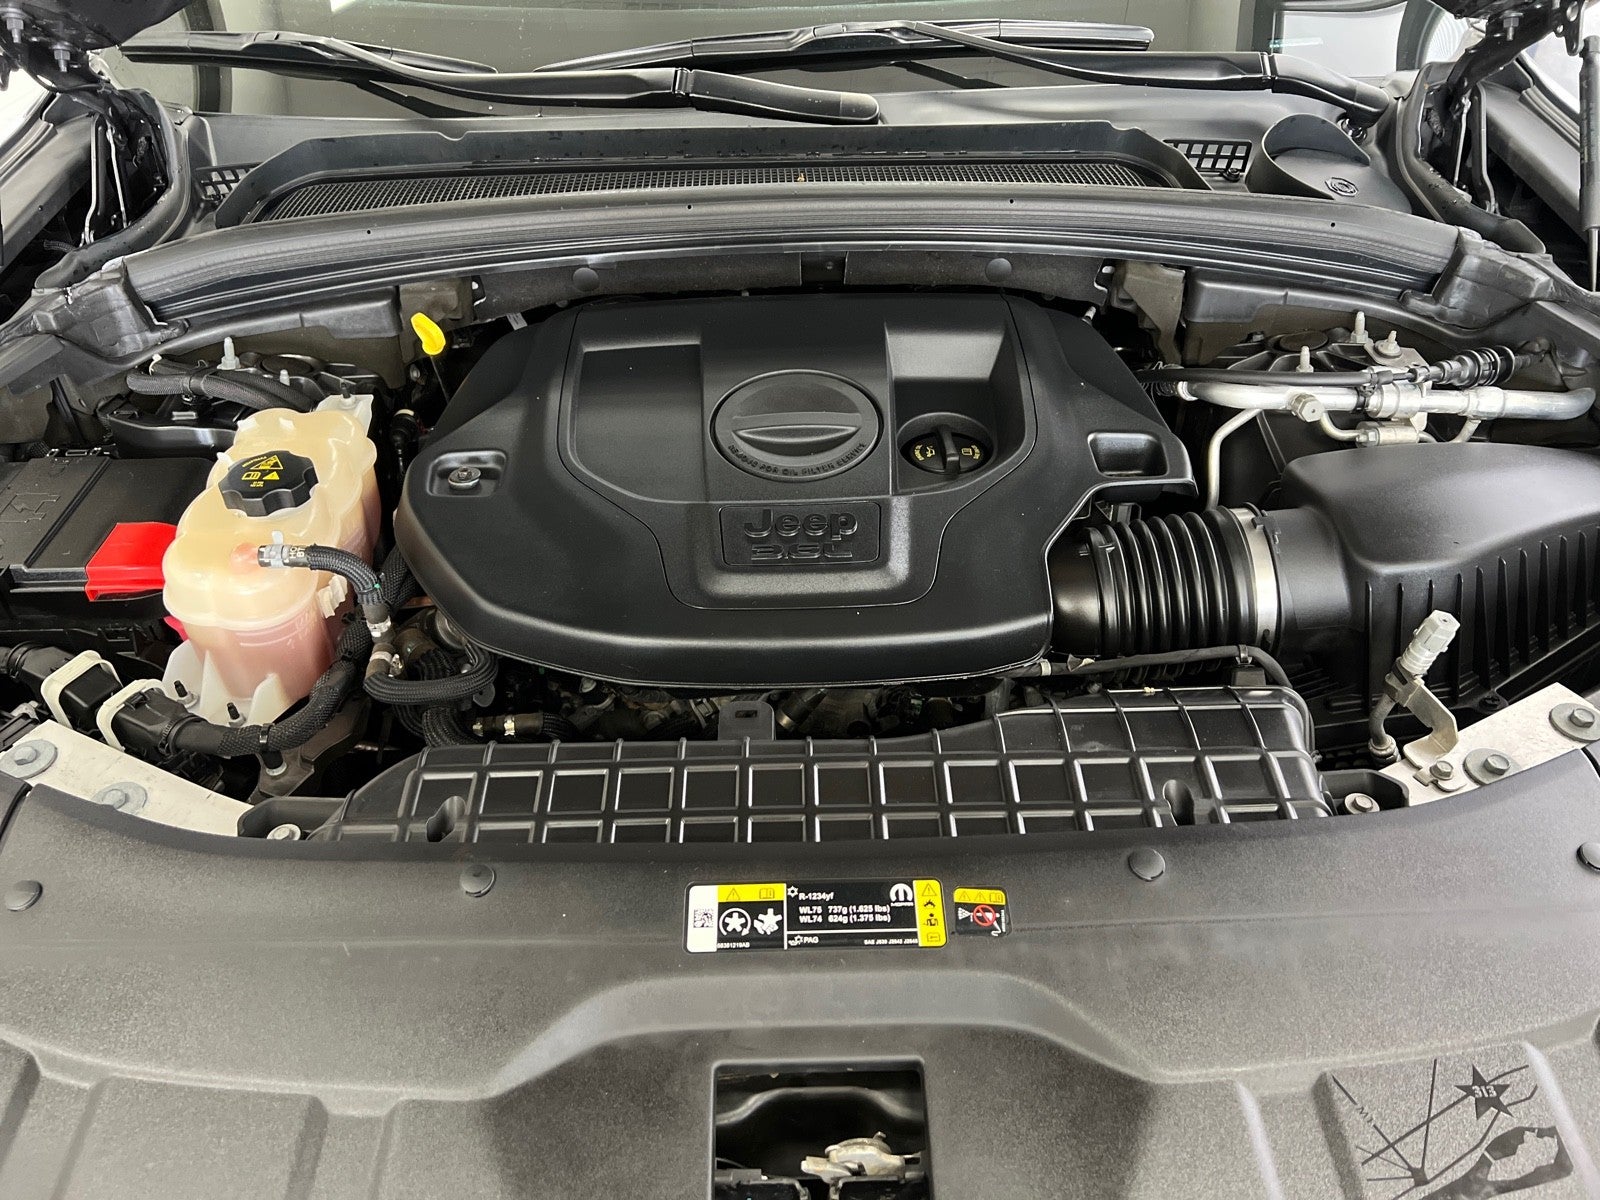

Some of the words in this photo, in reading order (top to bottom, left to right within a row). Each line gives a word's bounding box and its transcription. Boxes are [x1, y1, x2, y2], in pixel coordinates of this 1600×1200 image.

[744, 509, 858, 541] Jeep
[799, 892, 834, 902] R-1234yf
[799, 906, 822, 914] WL75
[828, 905, 848, 914] 737g
[874, 904, 890, 913] lbs)
[799, 915, 822, 923] WL74
[828, 915, 848, 924] 624g
[849, 914, 874, 923] (1.375
[874, 913, 891, 923] lbs)
[803, 936, 819, 944] PAG
[1471, 1085, 1497, 1098] 313
